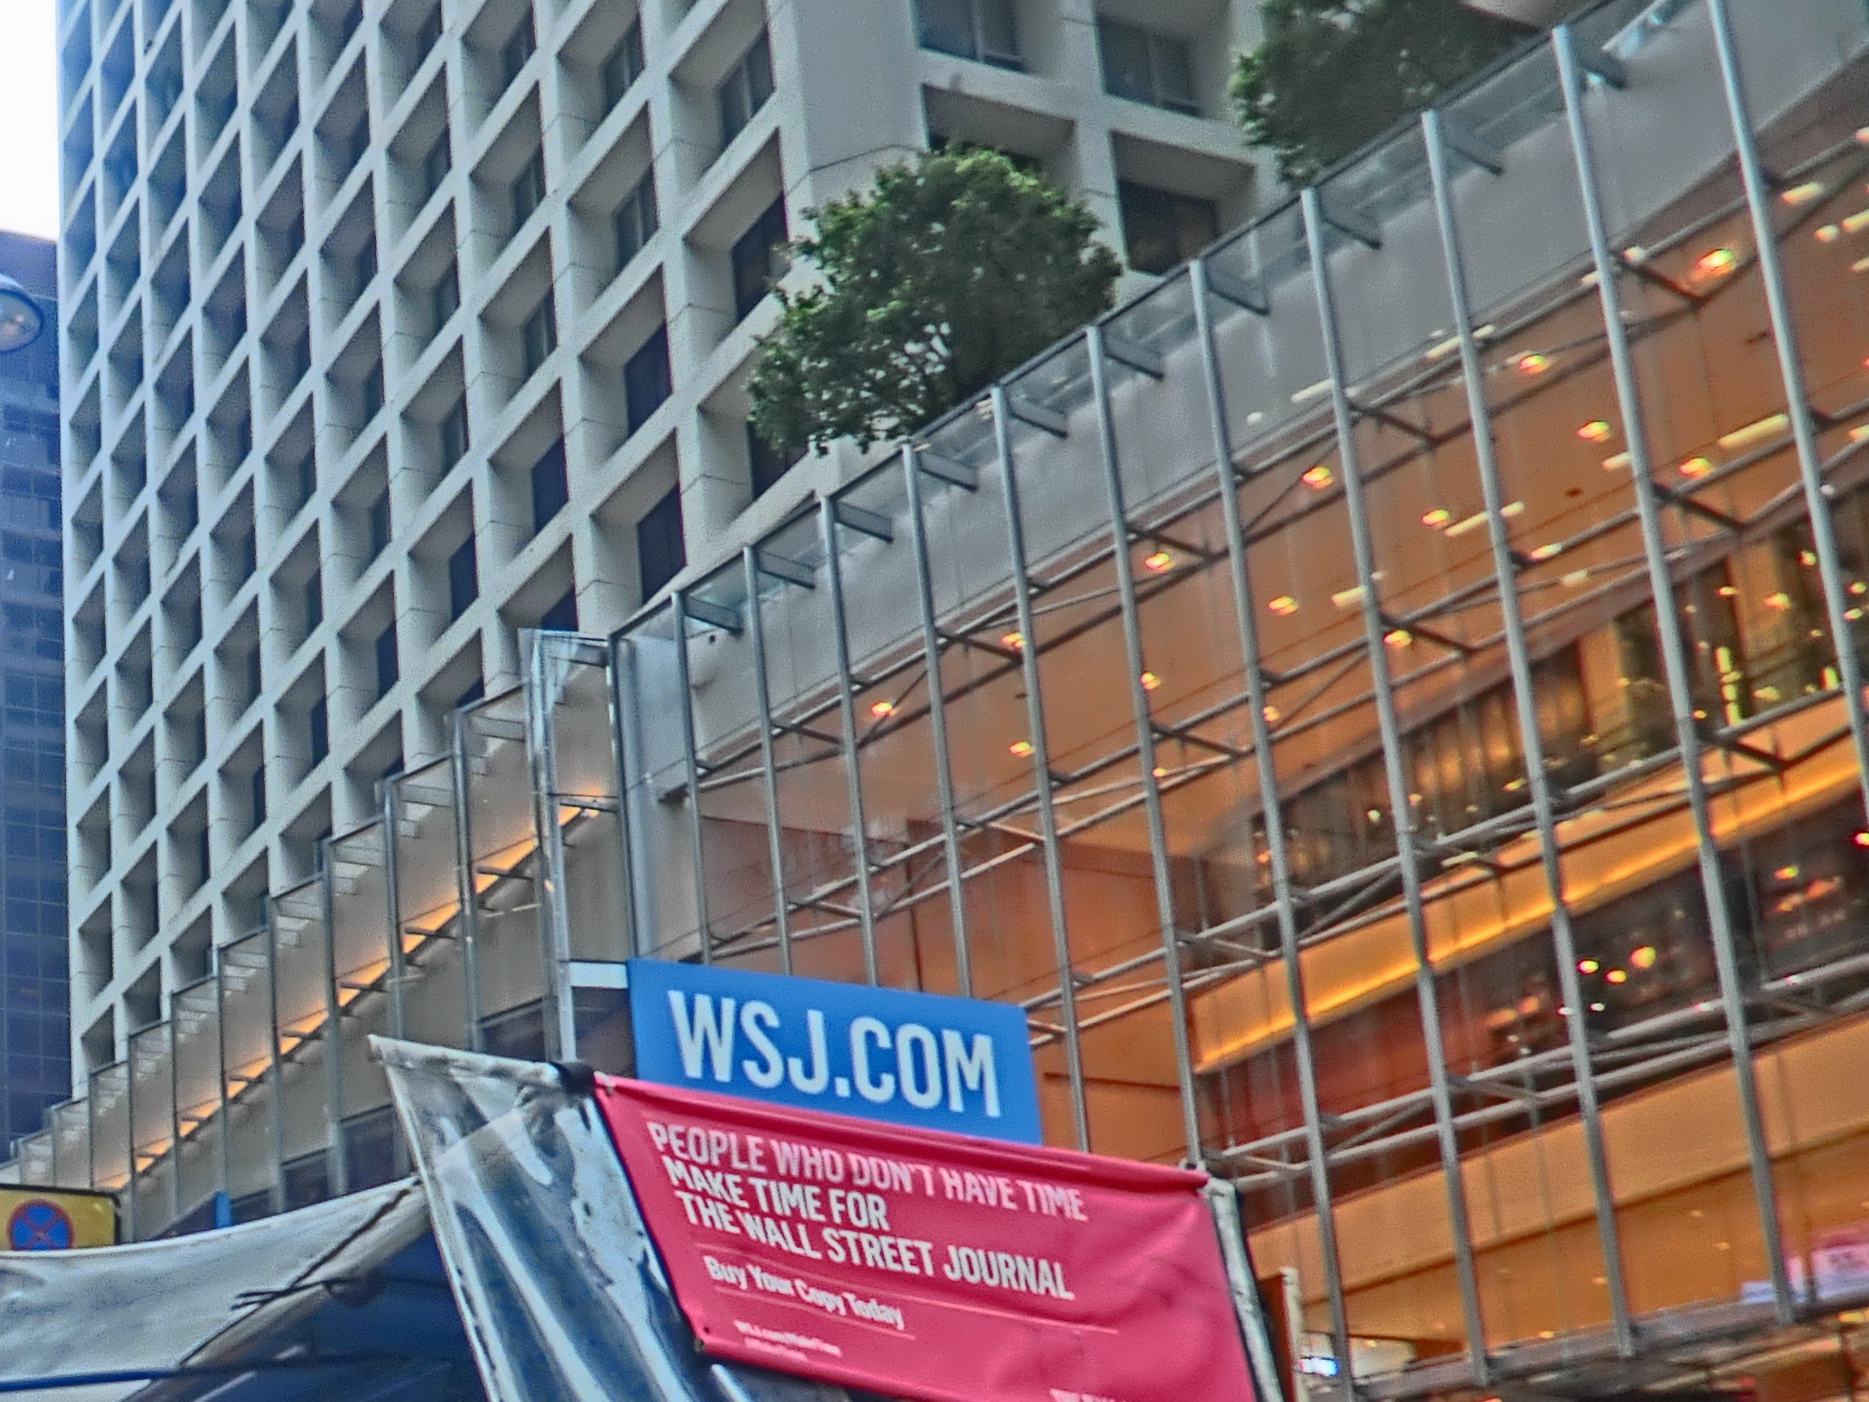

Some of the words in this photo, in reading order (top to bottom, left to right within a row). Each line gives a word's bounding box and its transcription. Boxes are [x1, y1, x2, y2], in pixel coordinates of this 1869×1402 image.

[668, 989, 1000, 1118] WSJ.COM
[647, 1122, 767, 1169] PEOPLE
[770, 1139, 845, 1182] WHO
[847, 1152, 934, 1196] DON'T
[940, 1167, 1018, 1211] HAVE
[1018, 1180, 1089, 1222] TIME
[662, 1156, 753, 1209] MAKE
[751, 1177, 826, 1223] TIME
[830, 1192, 890, 1231] FOR
[674, 1190, 742, 1235] THE
[738, 1210, 821, 1260] WALL
[824, 1227, 932, 1276] STREET
[944, 1245, 1076, 1299] JOURNAL
[703, 1256, 748, 1290] Buy
[746, 1264, 795, 1296] Your
[794, 1279, 846, 1315] Copy
[842, 1293, 905, 1331] Today
